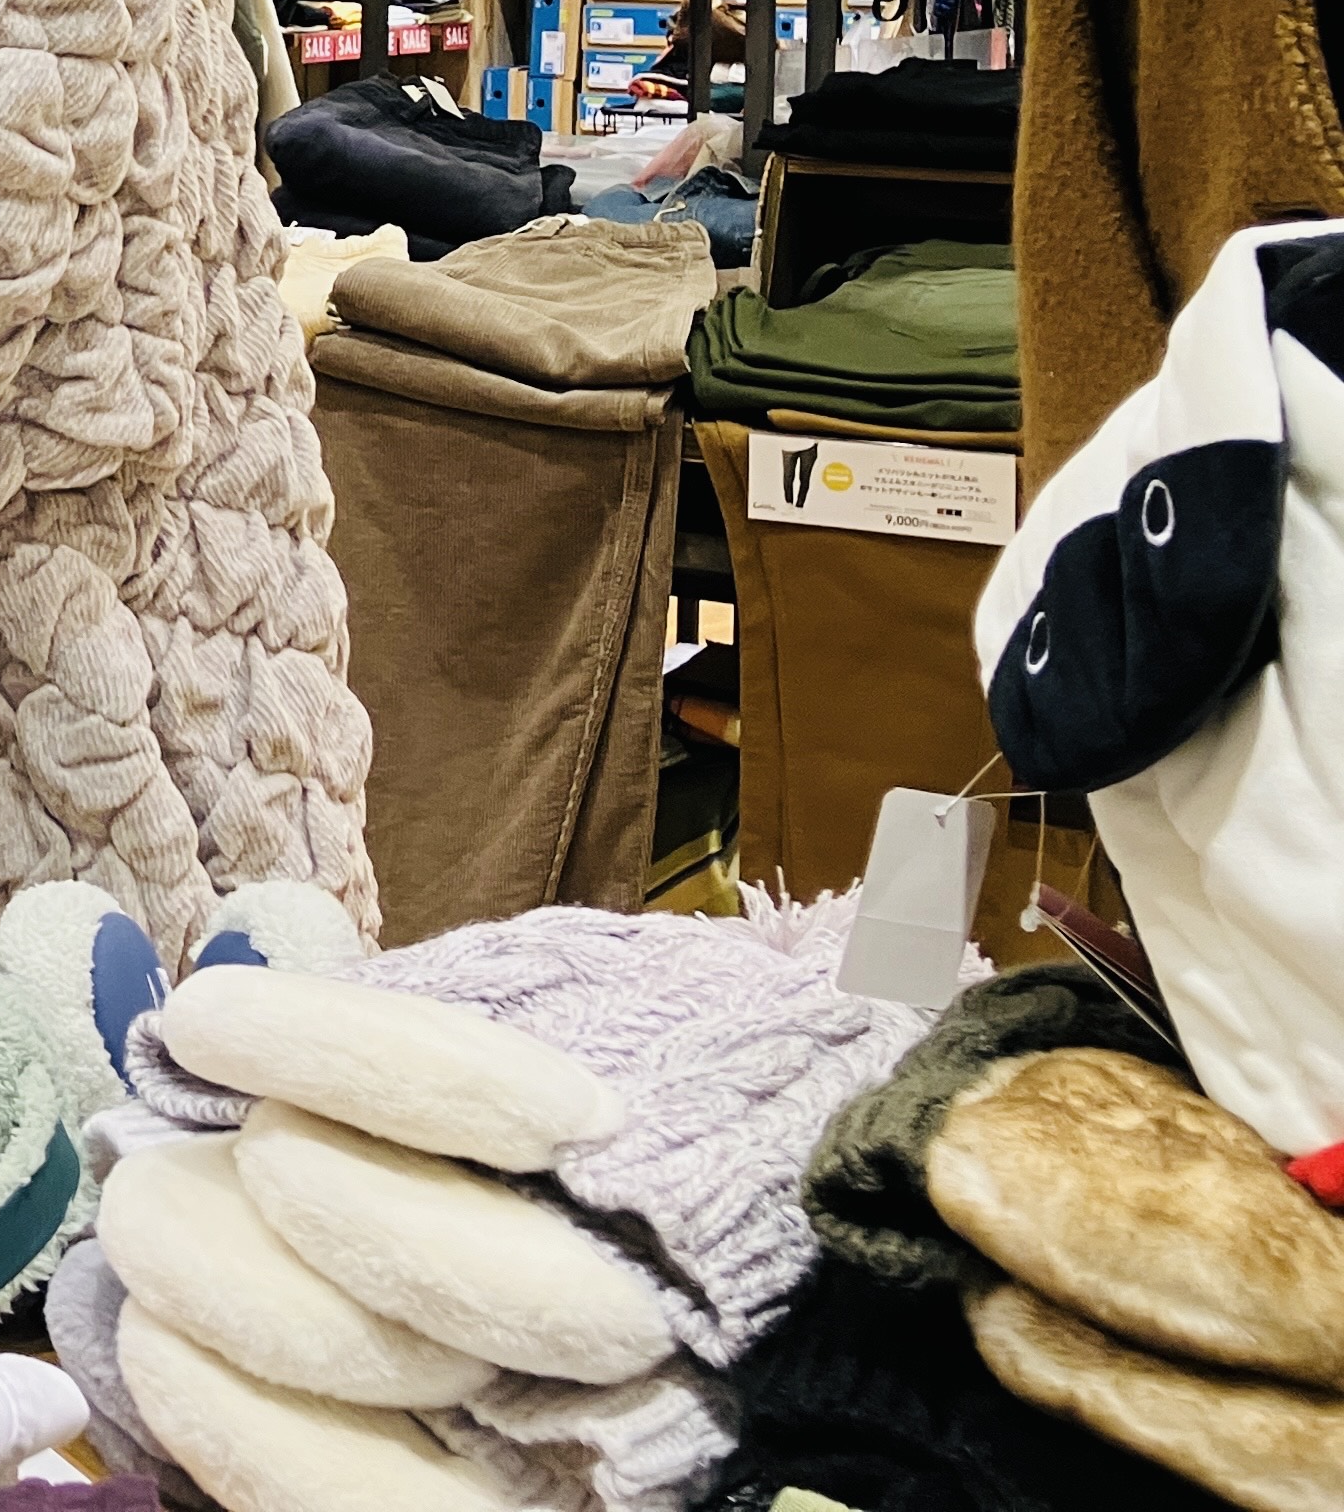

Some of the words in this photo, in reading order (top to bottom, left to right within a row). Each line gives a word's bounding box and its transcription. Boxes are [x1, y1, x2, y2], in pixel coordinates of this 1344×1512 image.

[338, 34, 361, 57] SAL
[402, 28, 427, 49] SALE
[446, 26, 469, 46] SALE
[305, 36, 331, 58] SALE
